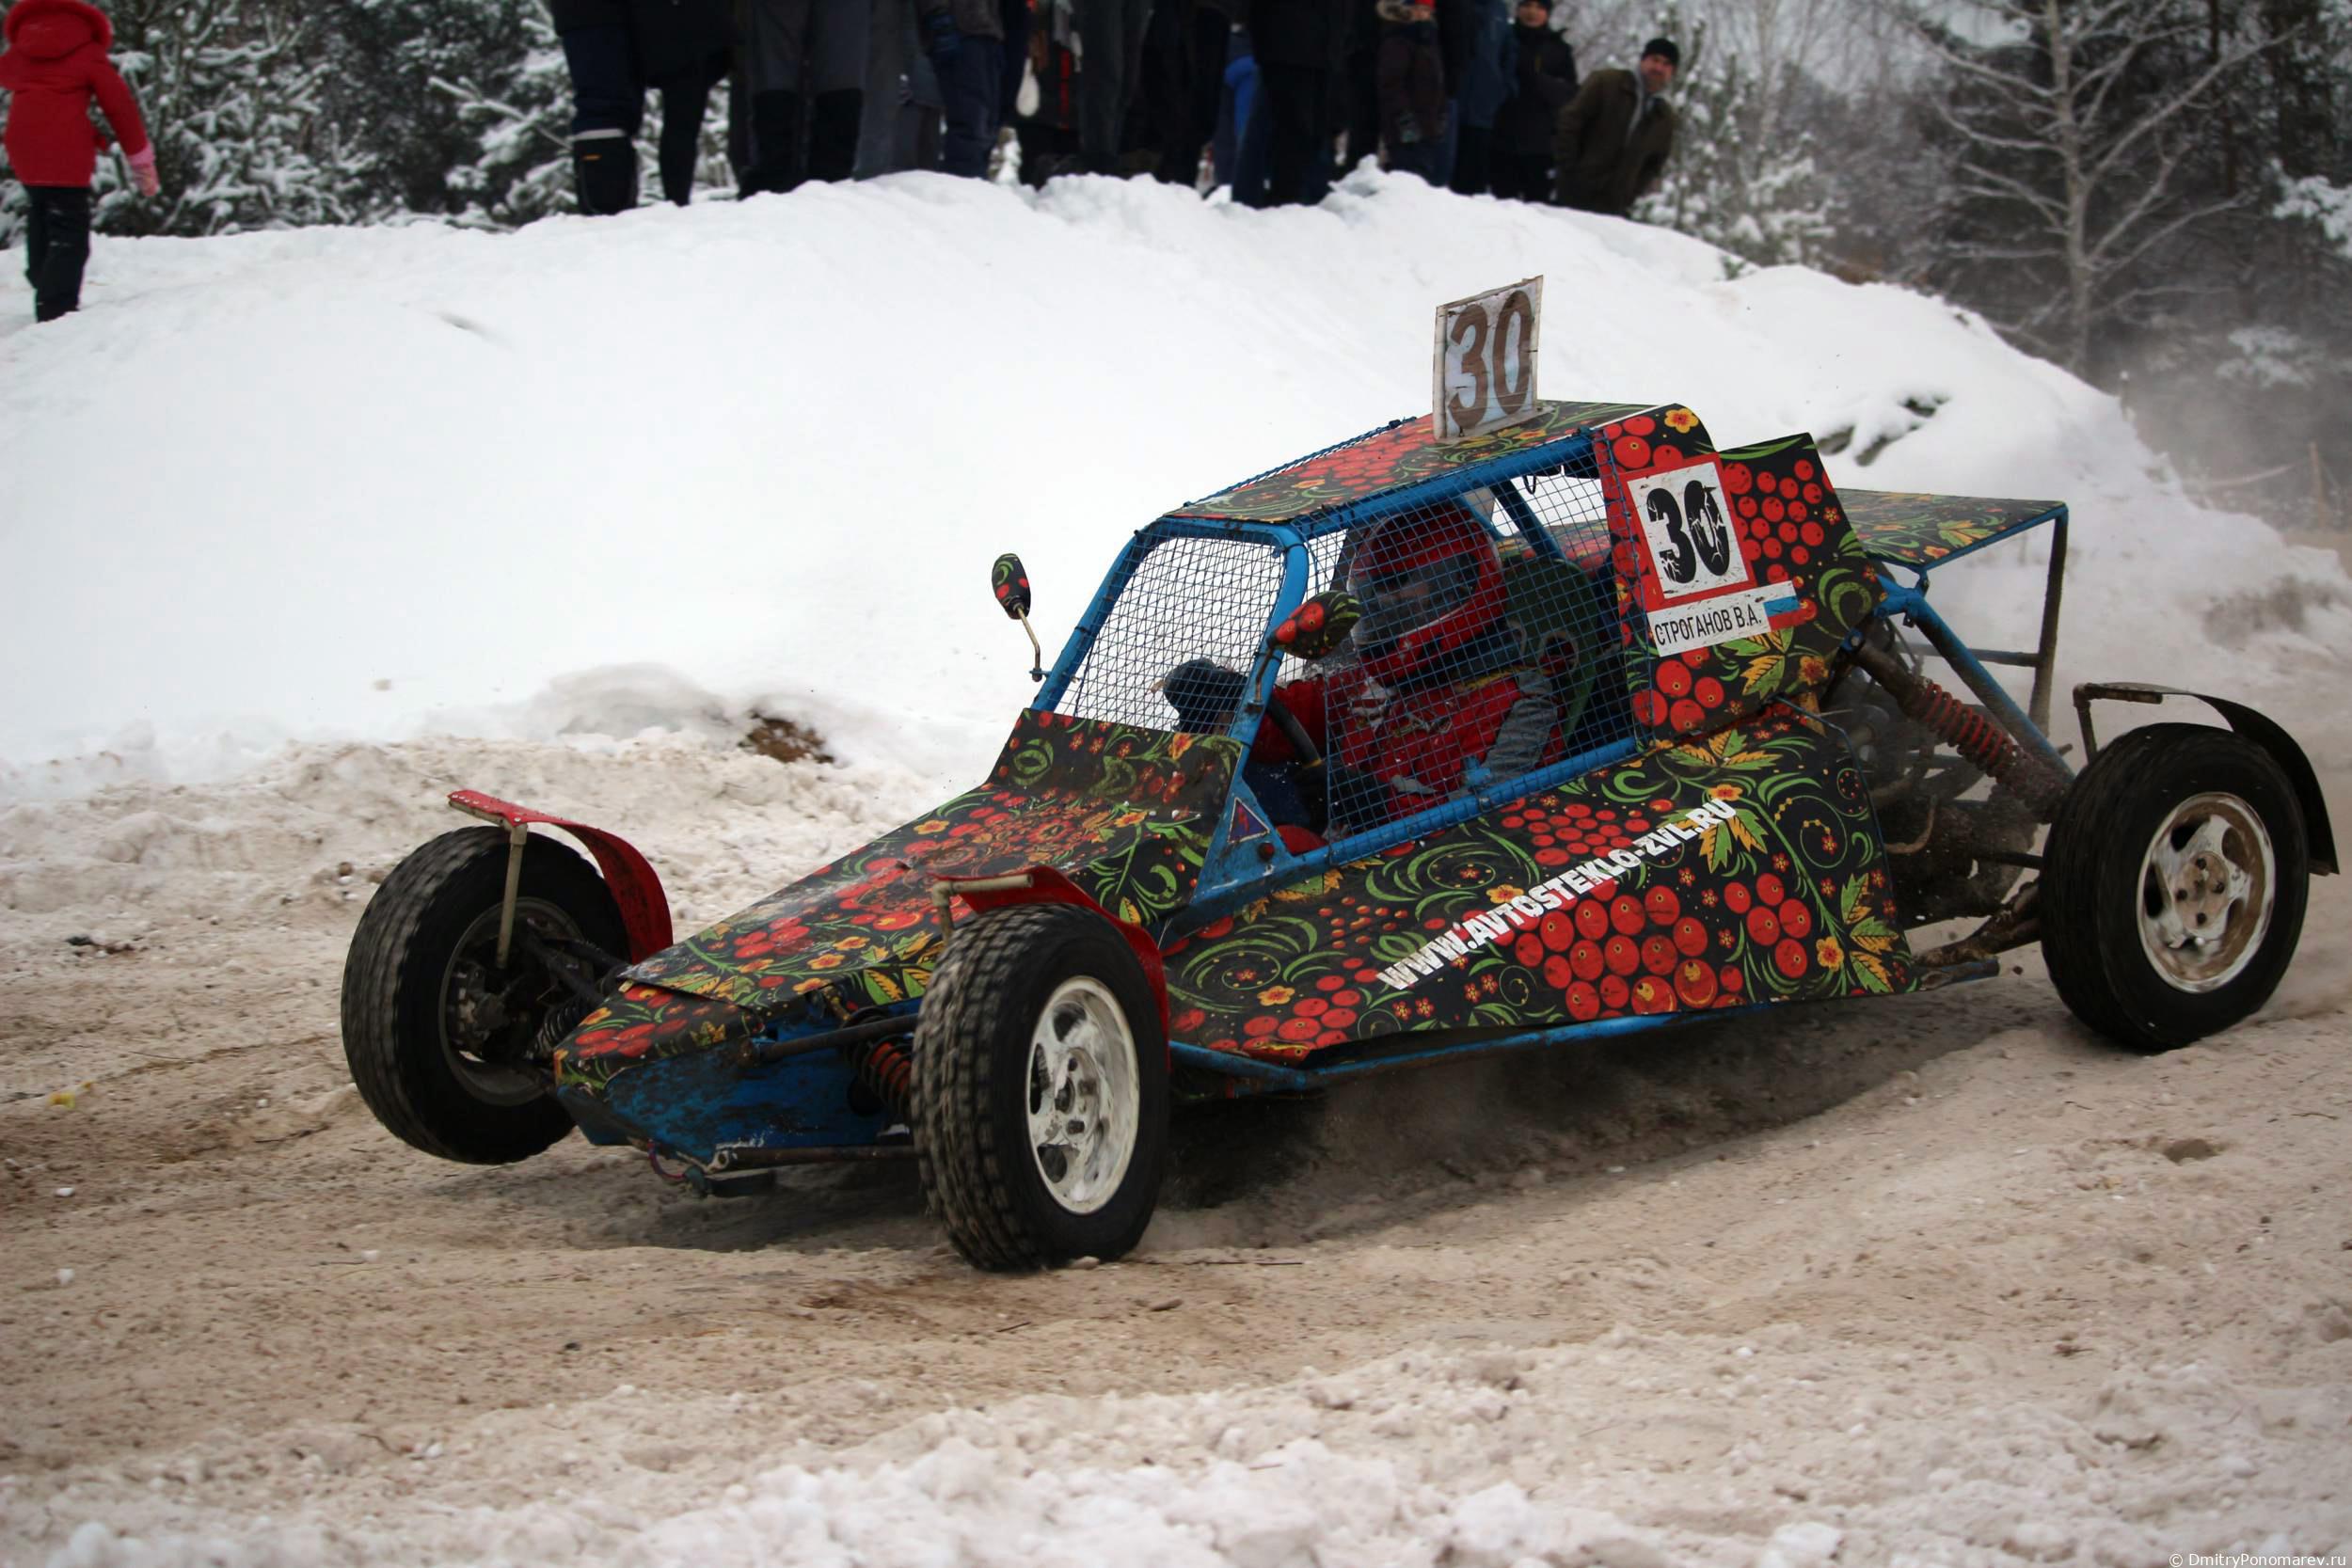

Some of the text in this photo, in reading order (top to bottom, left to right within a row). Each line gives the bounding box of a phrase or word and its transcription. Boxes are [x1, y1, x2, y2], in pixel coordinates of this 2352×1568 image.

[1448, 290, 1532, 429] 30
[1646, 480, 1730, 583] 30
[1654, 604, 1762, 645] СТРОГАНОВ В.А.
[1376, 798, 1737, 990] WWW.AVTOSTEKLO-ZVL.RU
